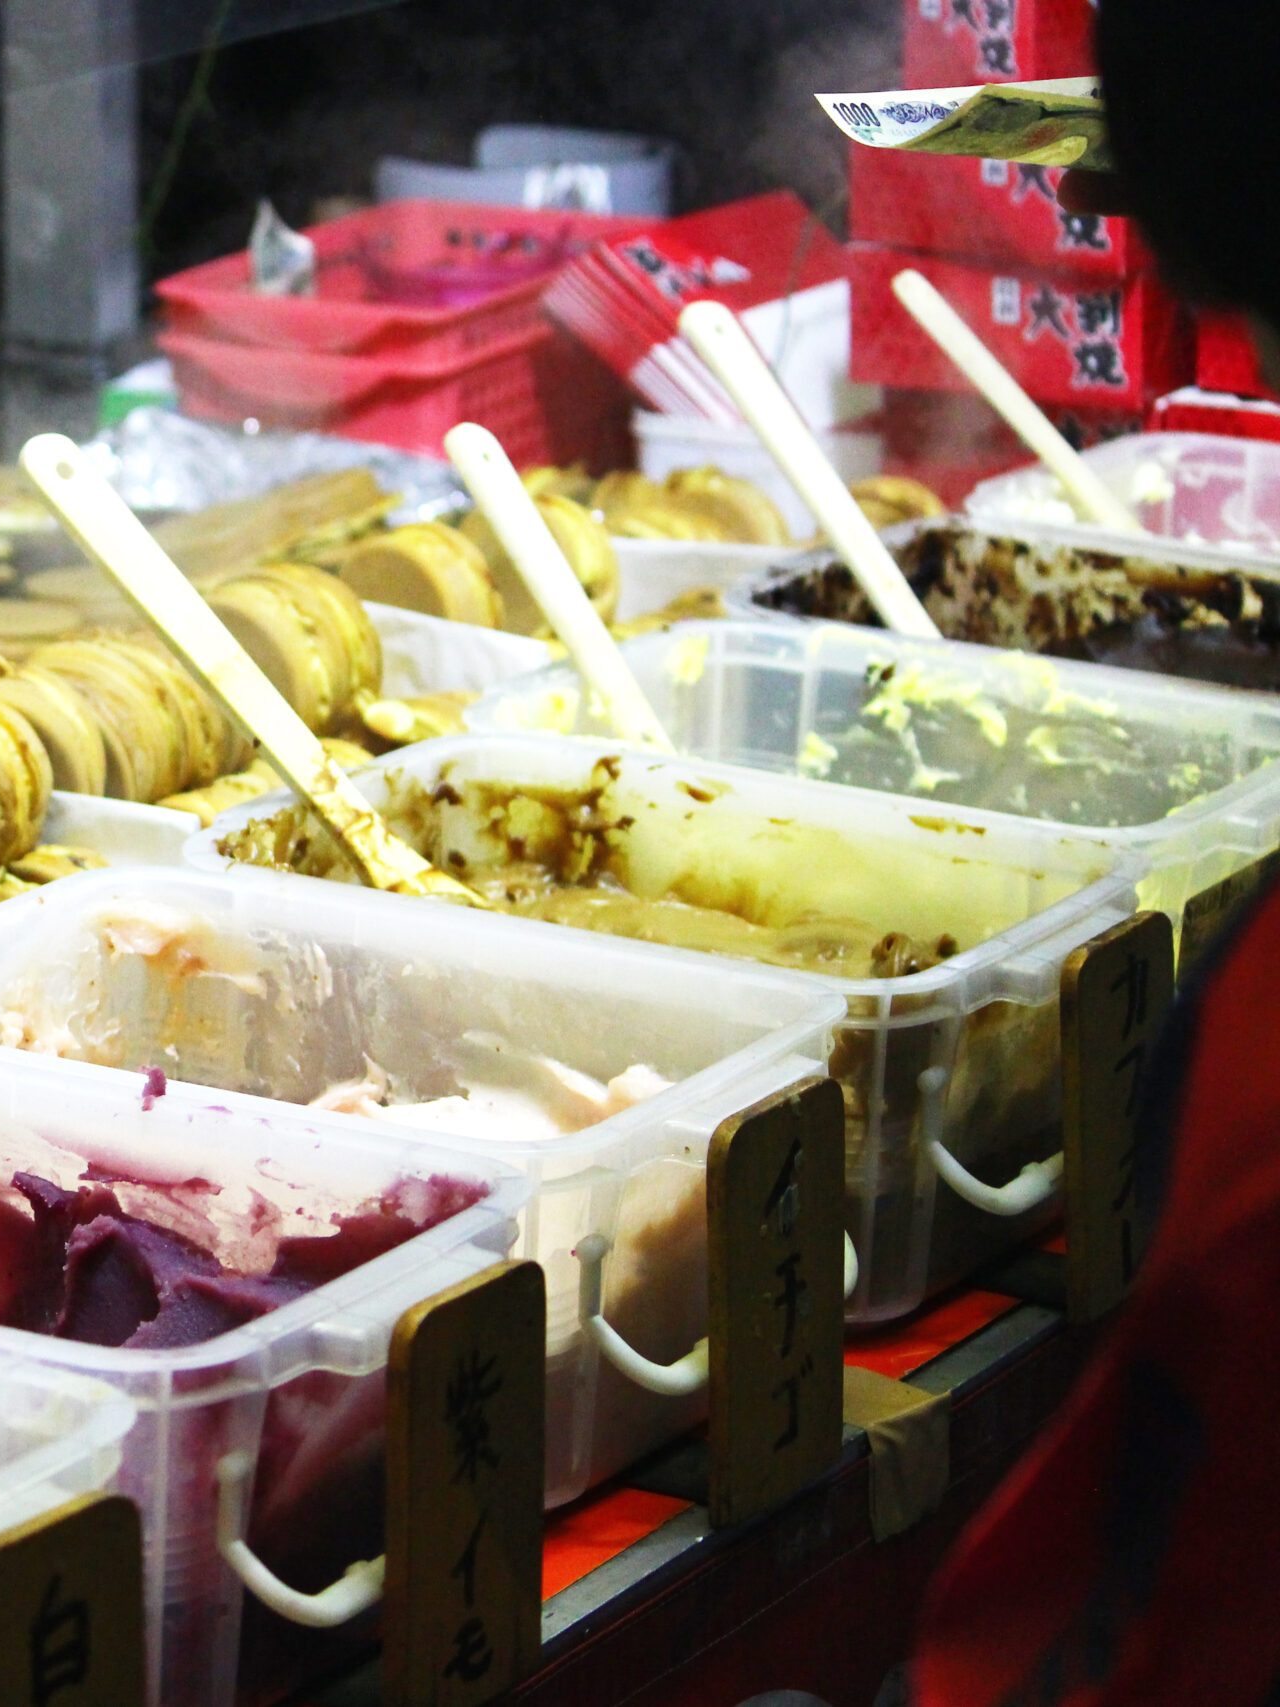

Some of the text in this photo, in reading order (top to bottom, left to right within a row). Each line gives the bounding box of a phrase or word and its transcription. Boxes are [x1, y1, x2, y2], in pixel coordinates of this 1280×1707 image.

[832, 102, 881, 127] 1000
[763, 1137, 814, 1453] イチゴ
[443, 1347, 504, 1682] 紫イモ
